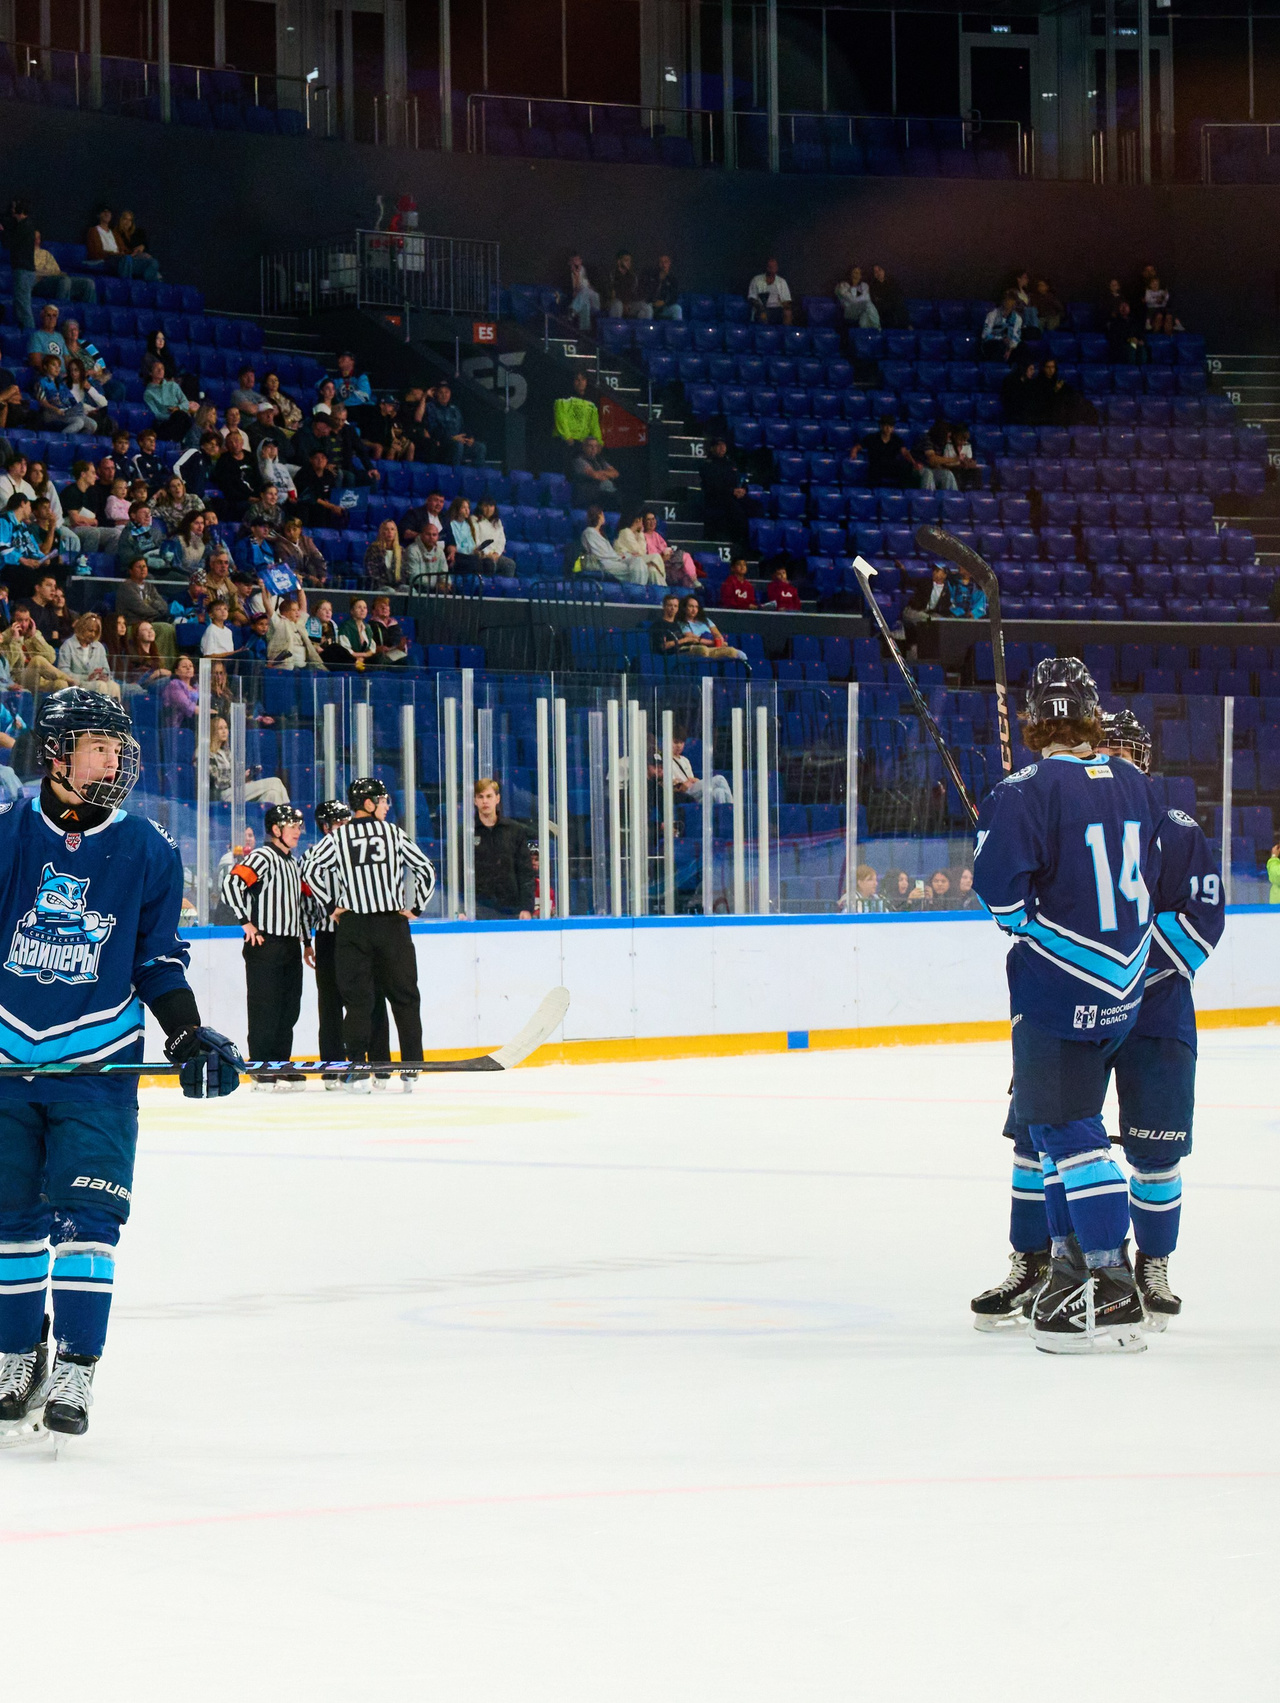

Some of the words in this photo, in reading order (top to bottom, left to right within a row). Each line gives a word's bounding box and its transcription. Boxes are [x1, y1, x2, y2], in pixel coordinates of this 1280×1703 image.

[478, 326, 494, 341] E5
[1206, 360, 1222, 373] 19
[690, 443, 705, 457] 16
[665, 506, 676, 520] 14
[718, 547, 732, 562] 13
[1053, 700, 1068, 717] 14
[995, 683, 1011, 771] CCM
[352, 837, 387, 864] 73
[1085, 820, 1150, 931] 14
[1190, 874, 1220, 906] 19
[29, 930, 80, 942] СИБИРСКИЕ
[1100, 1013, 1128, 1026] ОБЛАСТЬ
[170, 1030, 188, 1050] CCM
[1128, 1126, 1187, 1142] BAUER
